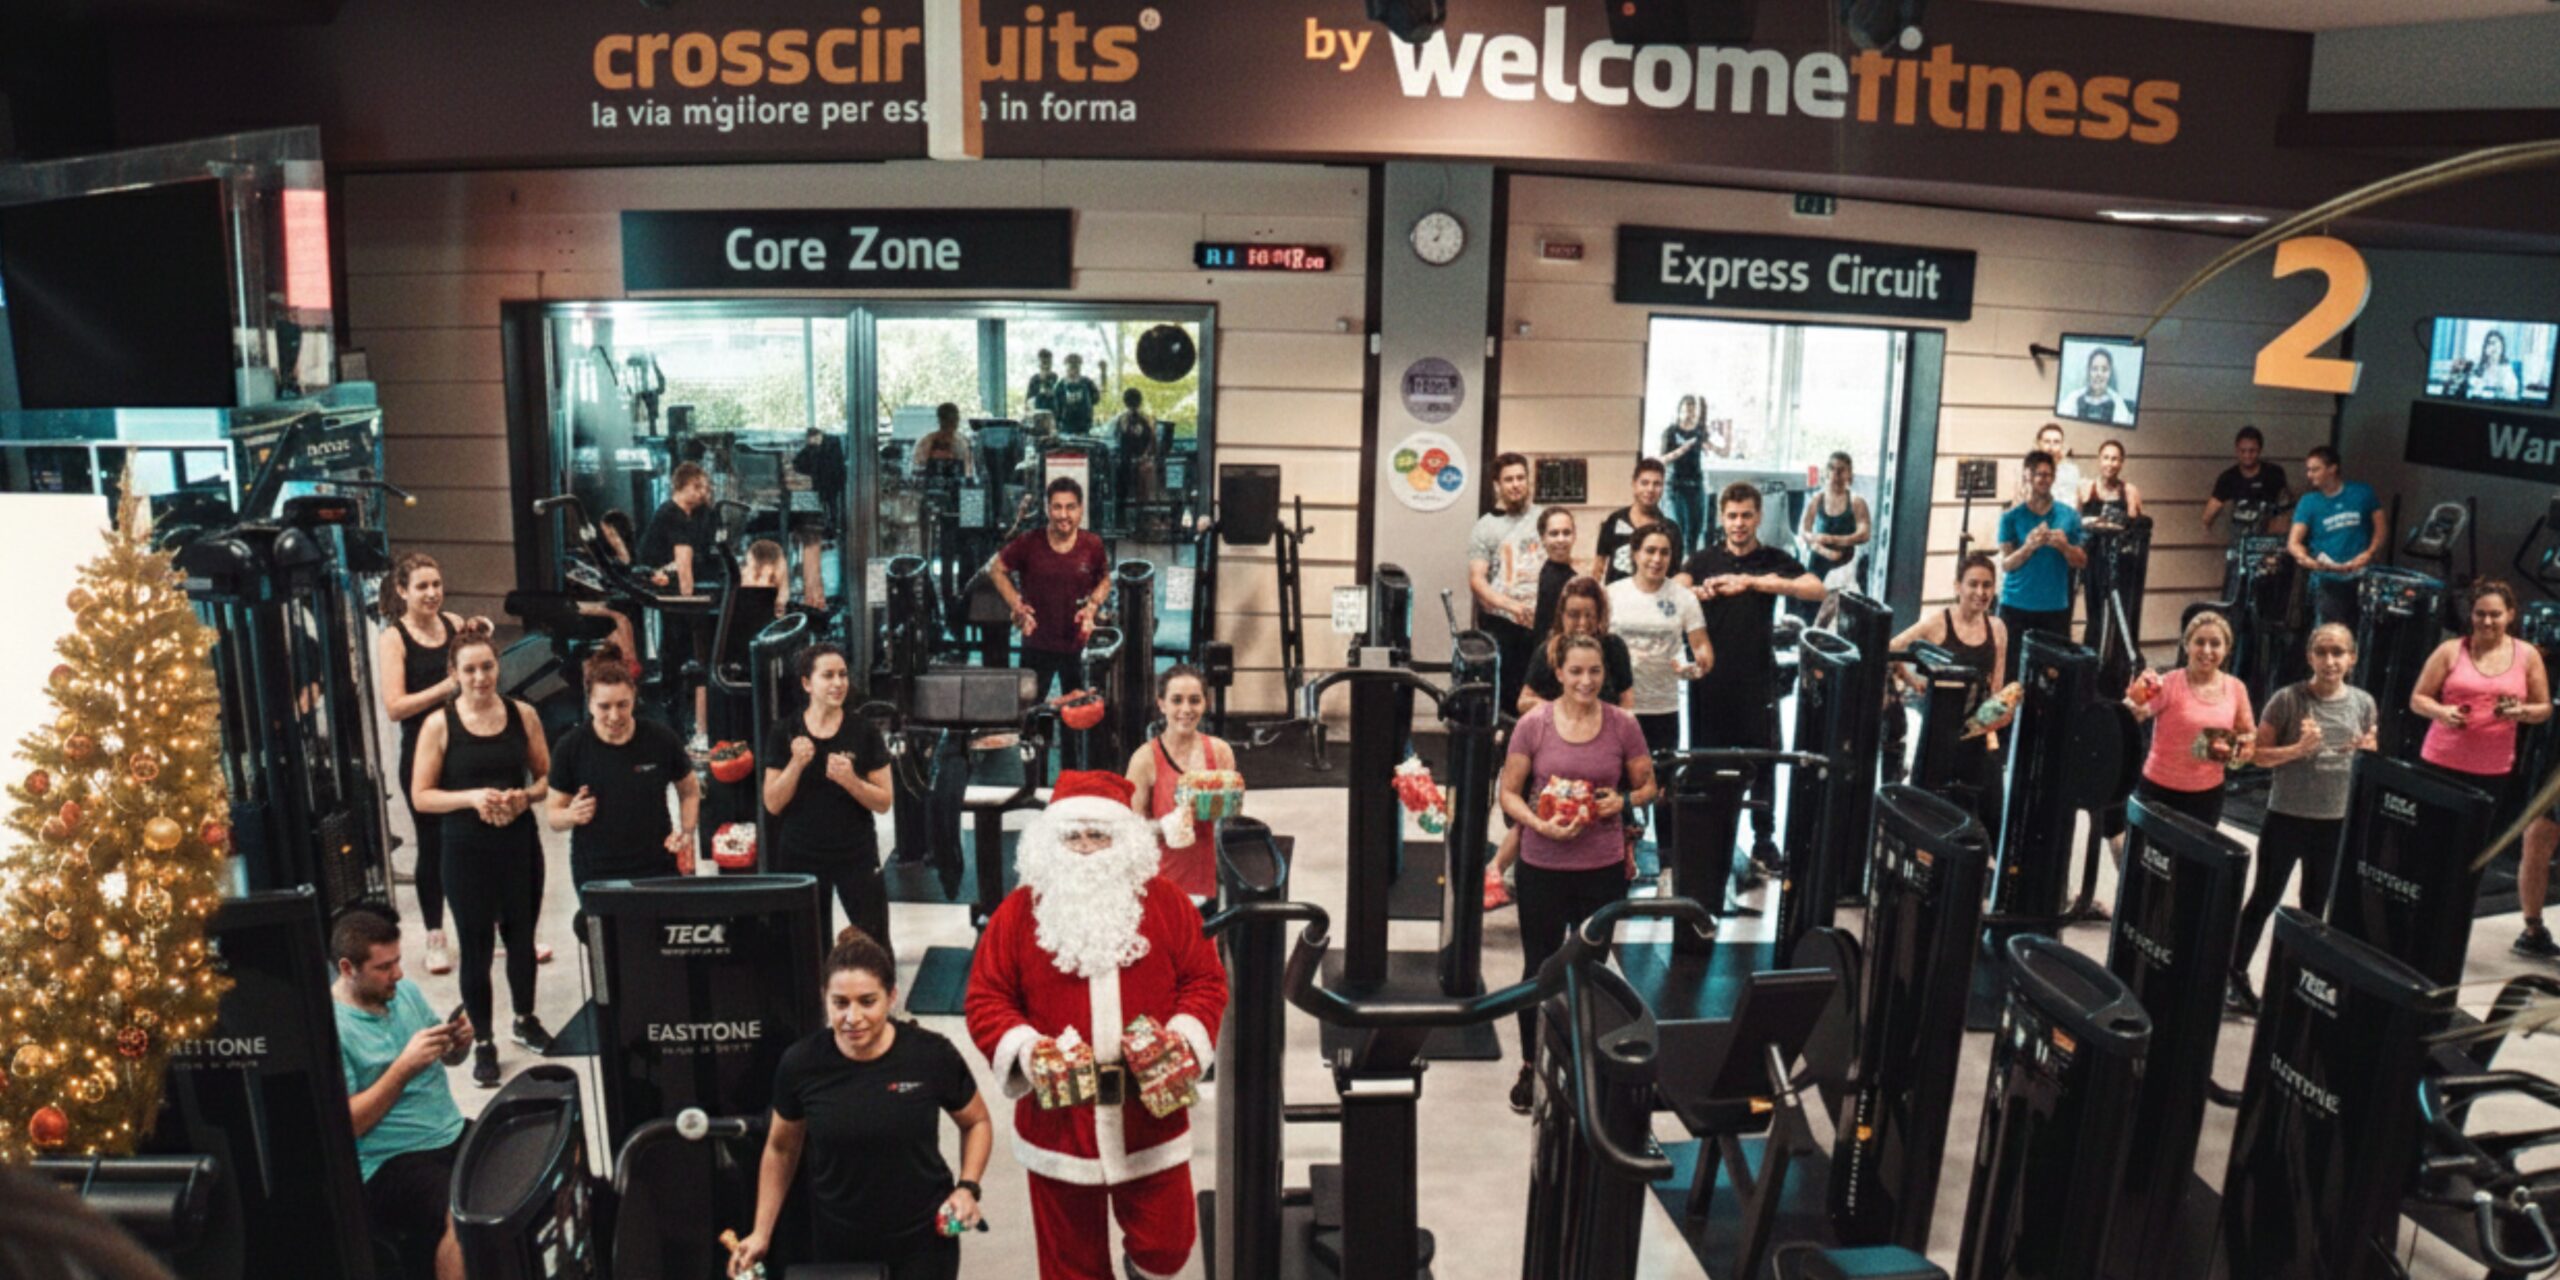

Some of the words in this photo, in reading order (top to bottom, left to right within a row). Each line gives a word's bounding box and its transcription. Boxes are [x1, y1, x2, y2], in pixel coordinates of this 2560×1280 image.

[593, 5, 1140, 90] crossciruits
[1306, 17, 1372, 71] by
[592, 102, 617, 128] la
[627, 99, 671, 126] via
[822, 101, 873, 130] per
[1000, 92, 1028, 120] in
[1040, 92, 1137, 122] forma
[726, 227, 826, 271] Core
[849, 226, 961, 271] Zone
[1660, 242, 1810, 300] Express
[1828, 253, 1941, 300] Circuit
[2253, 236, 2370, 394] 2
[648, 1020, 762, 1042] EASTTONE
